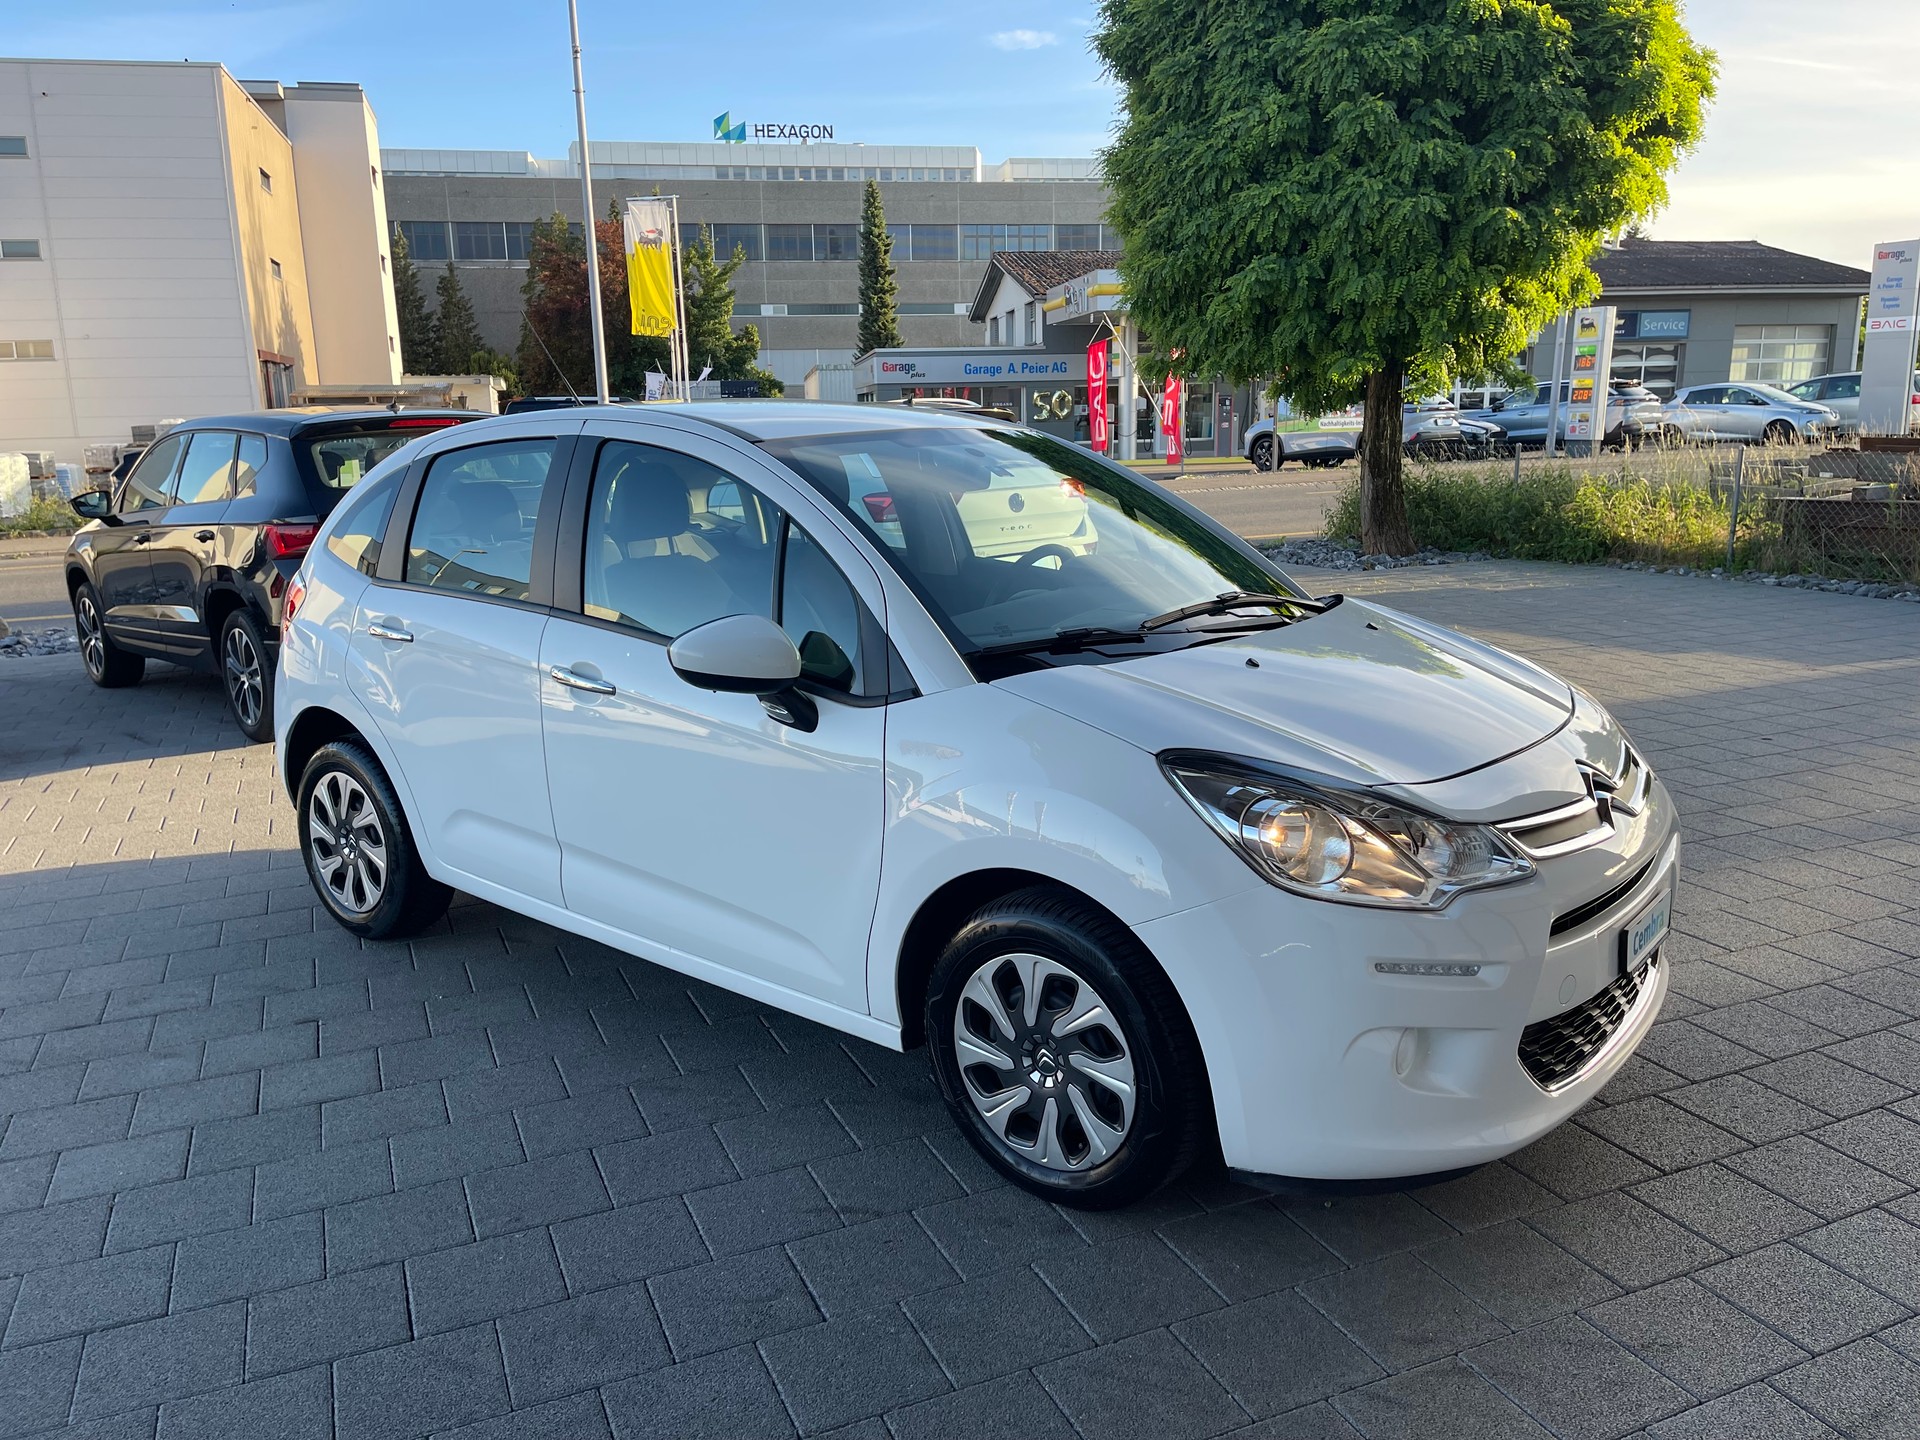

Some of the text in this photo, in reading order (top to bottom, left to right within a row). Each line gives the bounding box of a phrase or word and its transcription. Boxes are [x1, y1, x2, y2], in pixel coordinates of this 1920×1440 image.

[754, 124, 833, 139] HEXAGON
[1878, 250, 1906, 261] Garage
[1643, 319, 1686, 331] Service
[1871, 319, 1907, 330] BAIC
[882, 362, 916, 374] Garage
[964, 361, 1067, 377] Garage A. Peier AG
[1033, 389, 1073, 421] 50
[1633, 910, 1665, 956] Cembra
